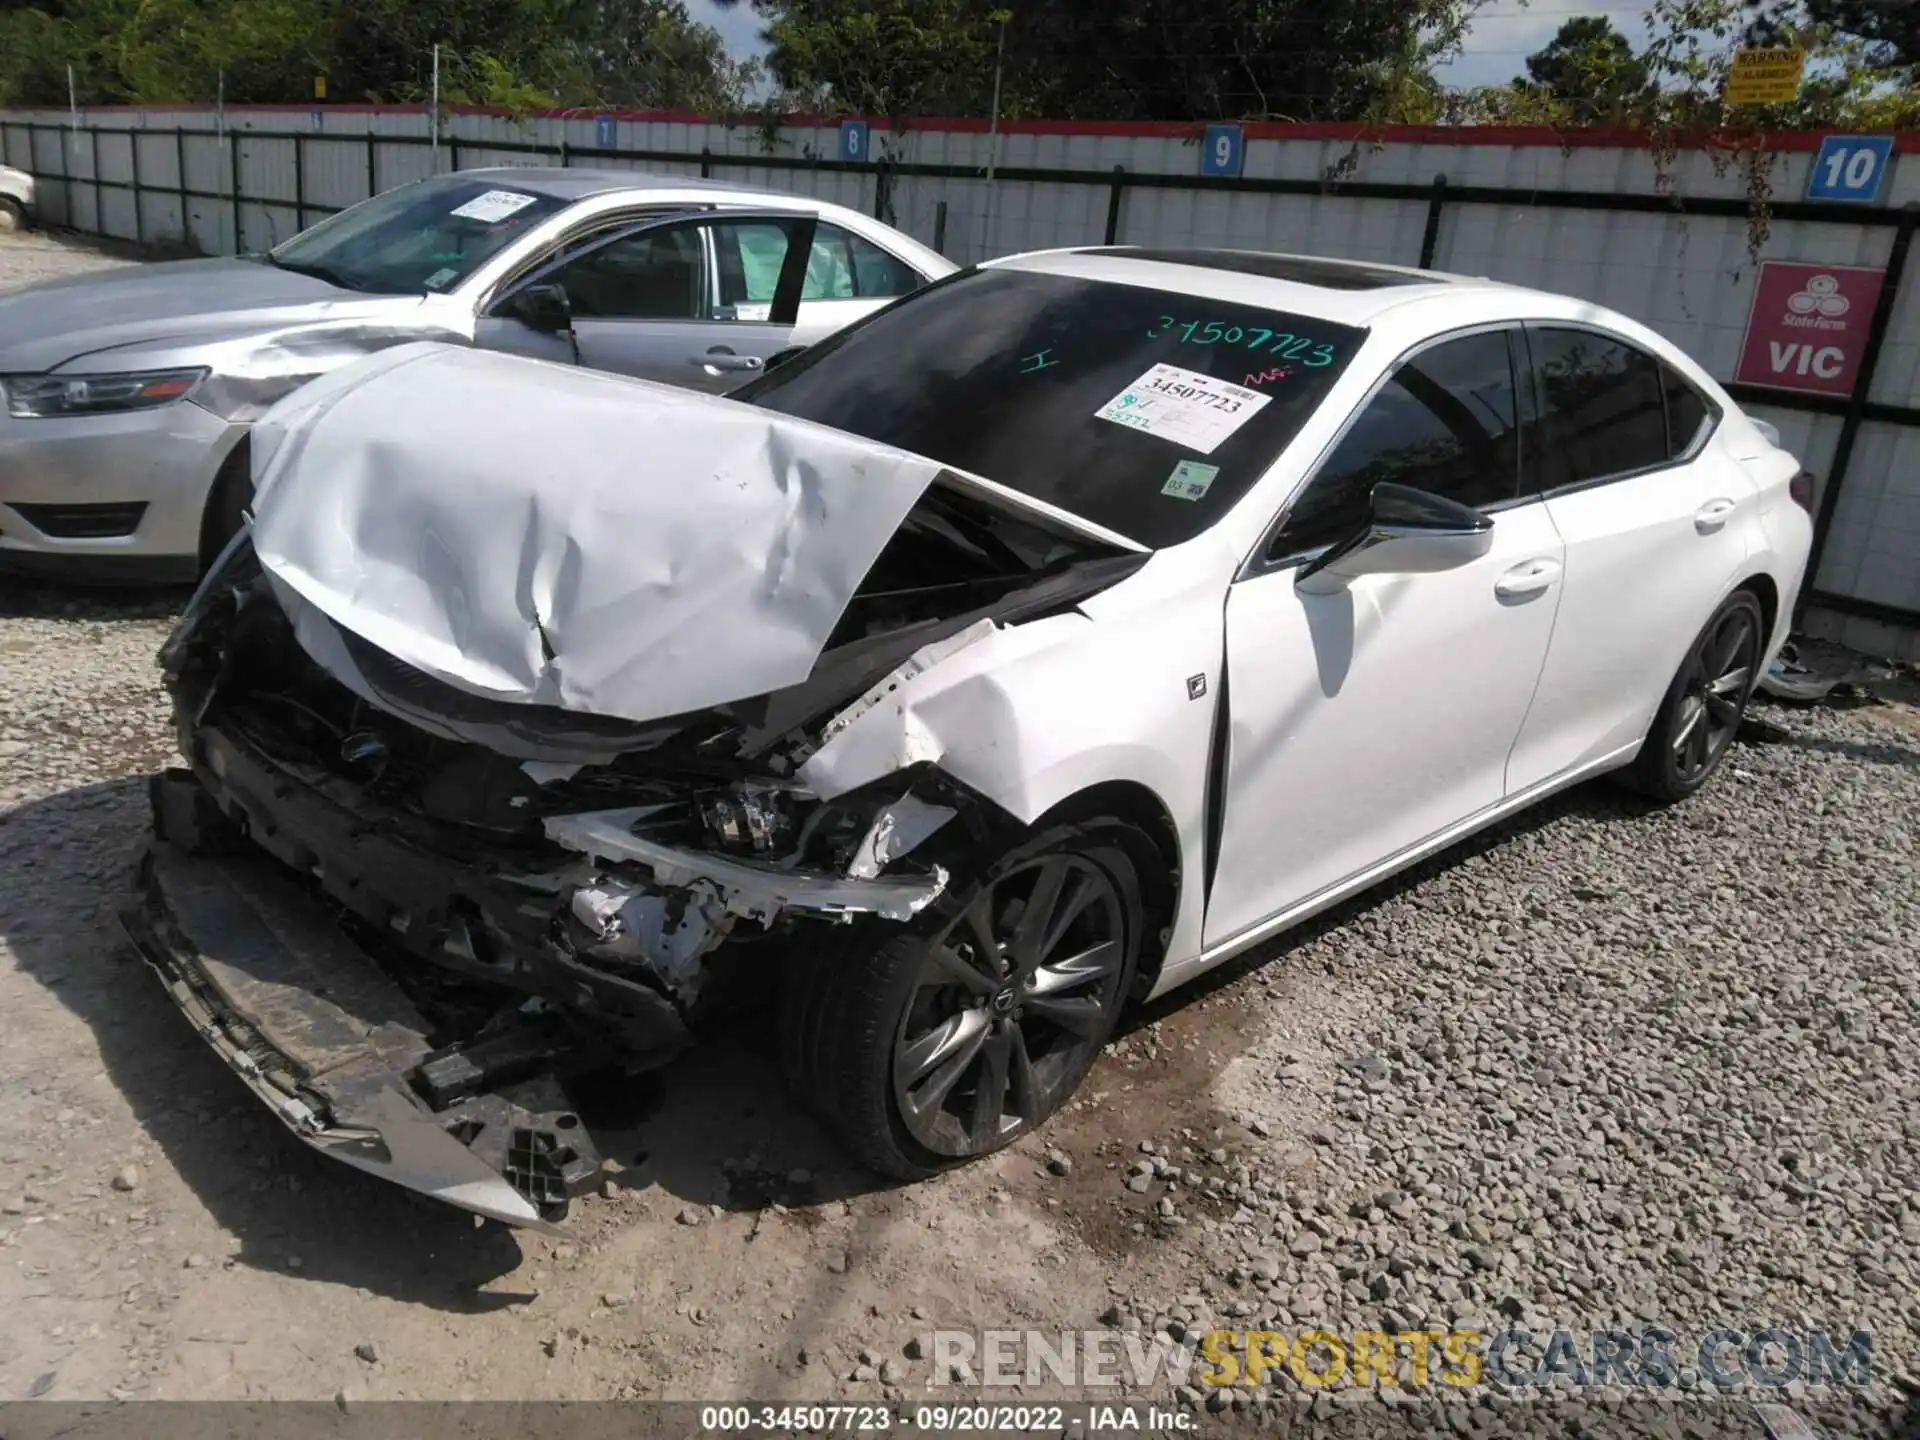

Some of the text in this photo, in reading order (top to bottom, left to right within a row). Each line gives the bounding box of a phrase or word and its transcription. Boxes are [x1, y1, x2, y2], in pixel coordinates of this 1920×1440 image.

[849, 129, 858, 154] 8
[1216, 136, 1231, 167] 9
[1825, 148, 1876, 189] 10
[1769, 341, 1845, 378] VIC
[1145, 377, 1243, 414] 34507723
